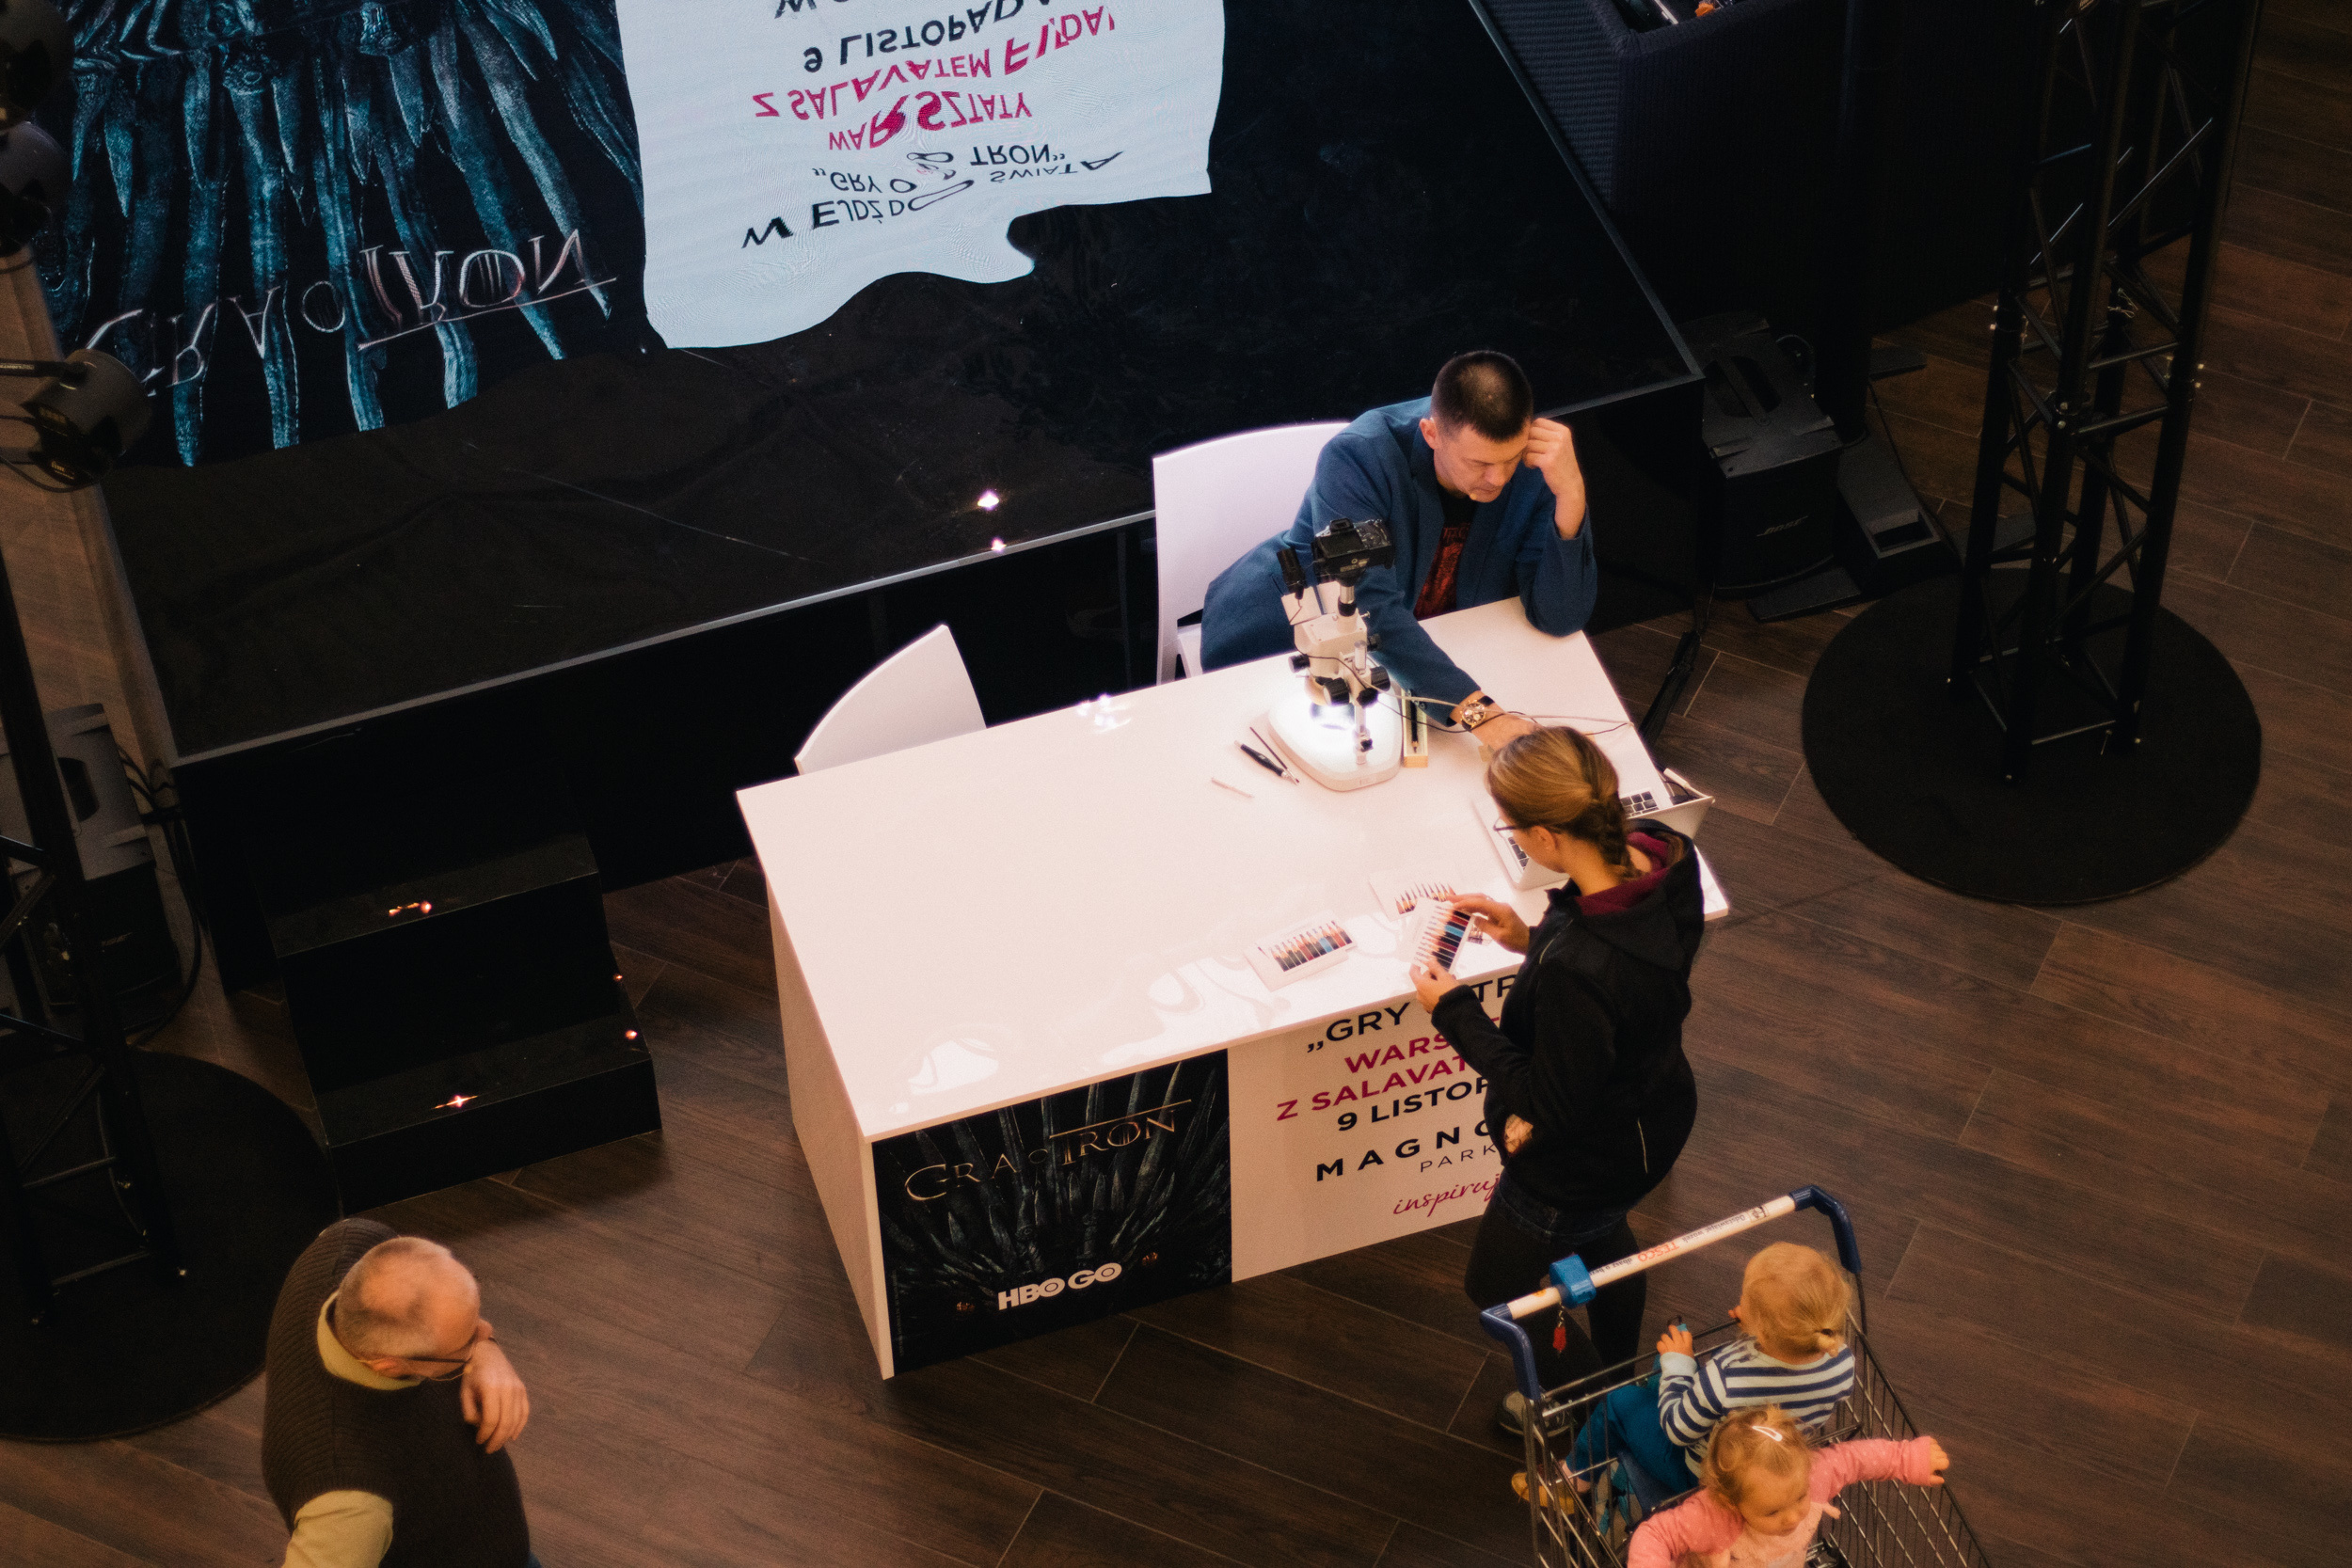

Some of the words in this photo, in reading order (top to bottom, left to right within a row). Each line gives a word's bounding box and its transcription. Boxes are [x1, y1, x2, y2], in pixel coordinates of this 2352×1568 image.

[1344, 1033, 1451, 1073] WARS
[1277, 1099, 1298, 1121] Z
[1311, 1055, 1466, 1111] SALAVAT
[1337, 1112, 1358, 1132] 9
[1371, 1076, 1488, 1123] LISTOP
[904, 1152, 1022, 1201] GRA
[1049, 1099, 1192, 1166] TRON
[1392, 1173, 1501, 1217] inspiruj
[1637, 1240, 1680, 1262] TESCO
[998, 1277, 1065, 1310] HBO
[1068, 1262, 1122, 1290] GO
